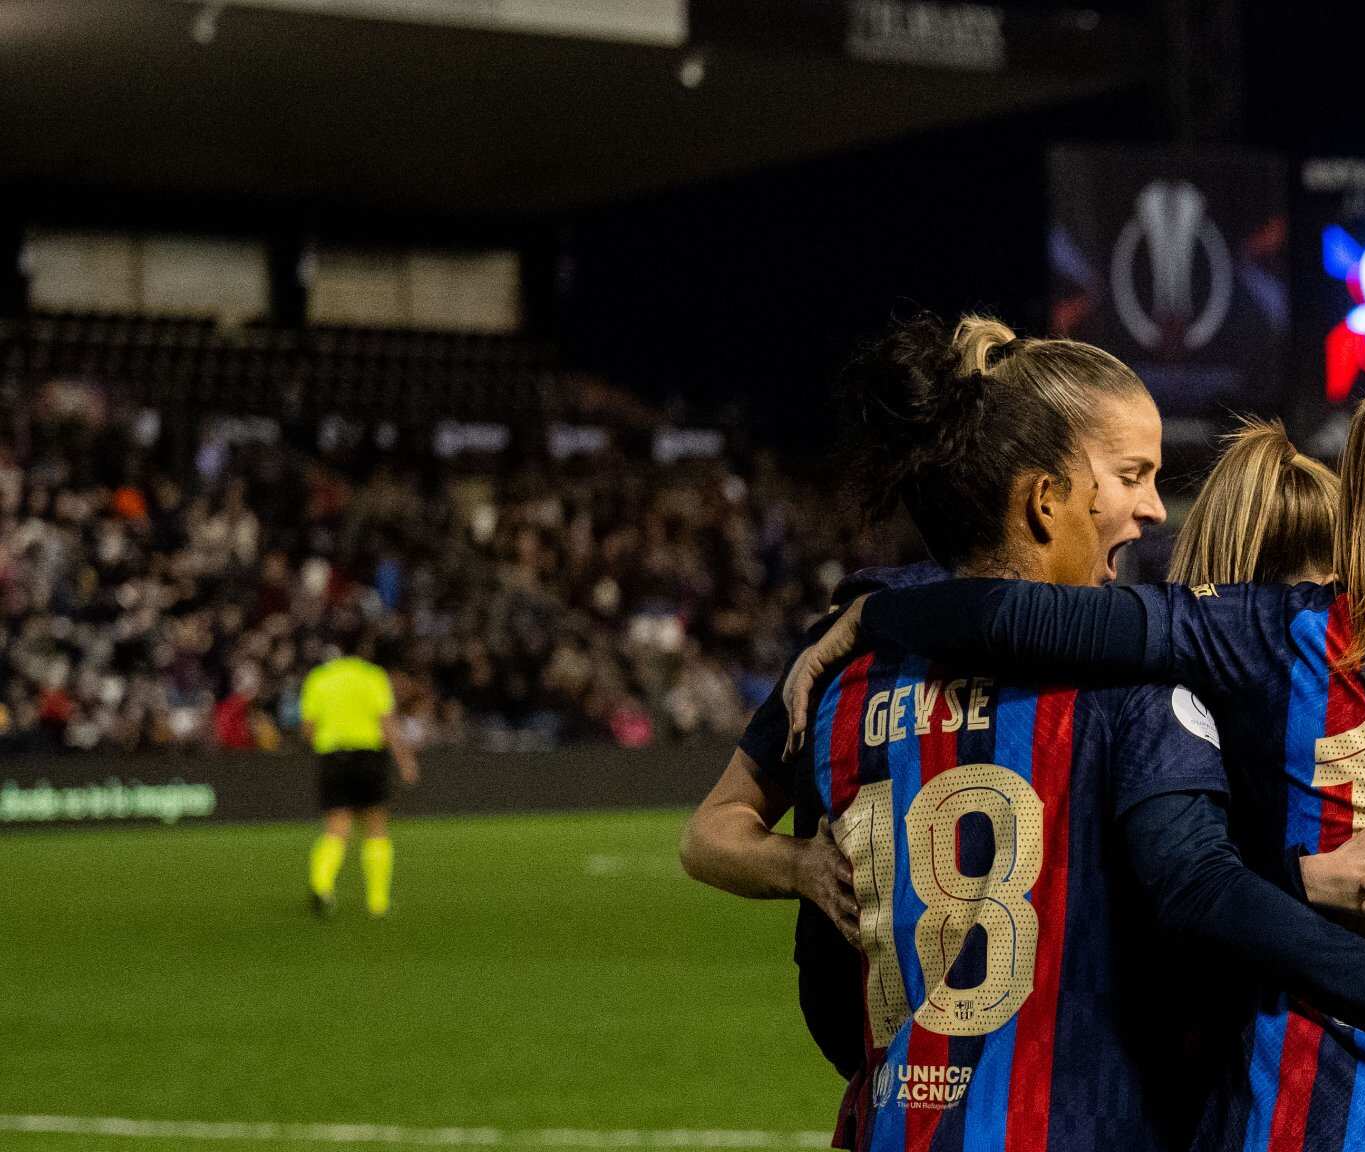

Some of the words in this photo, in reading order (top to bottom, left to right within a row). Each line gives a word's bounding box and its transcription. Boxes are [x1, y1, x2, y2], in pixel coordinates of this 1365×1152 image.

[864, 677, 993, 747] GEYSE
[830, 763, 1046, 1048] 18
[896, 1083, 967, 1102] ACNUR
[897, 1064, 973, 1084] UNHCR
